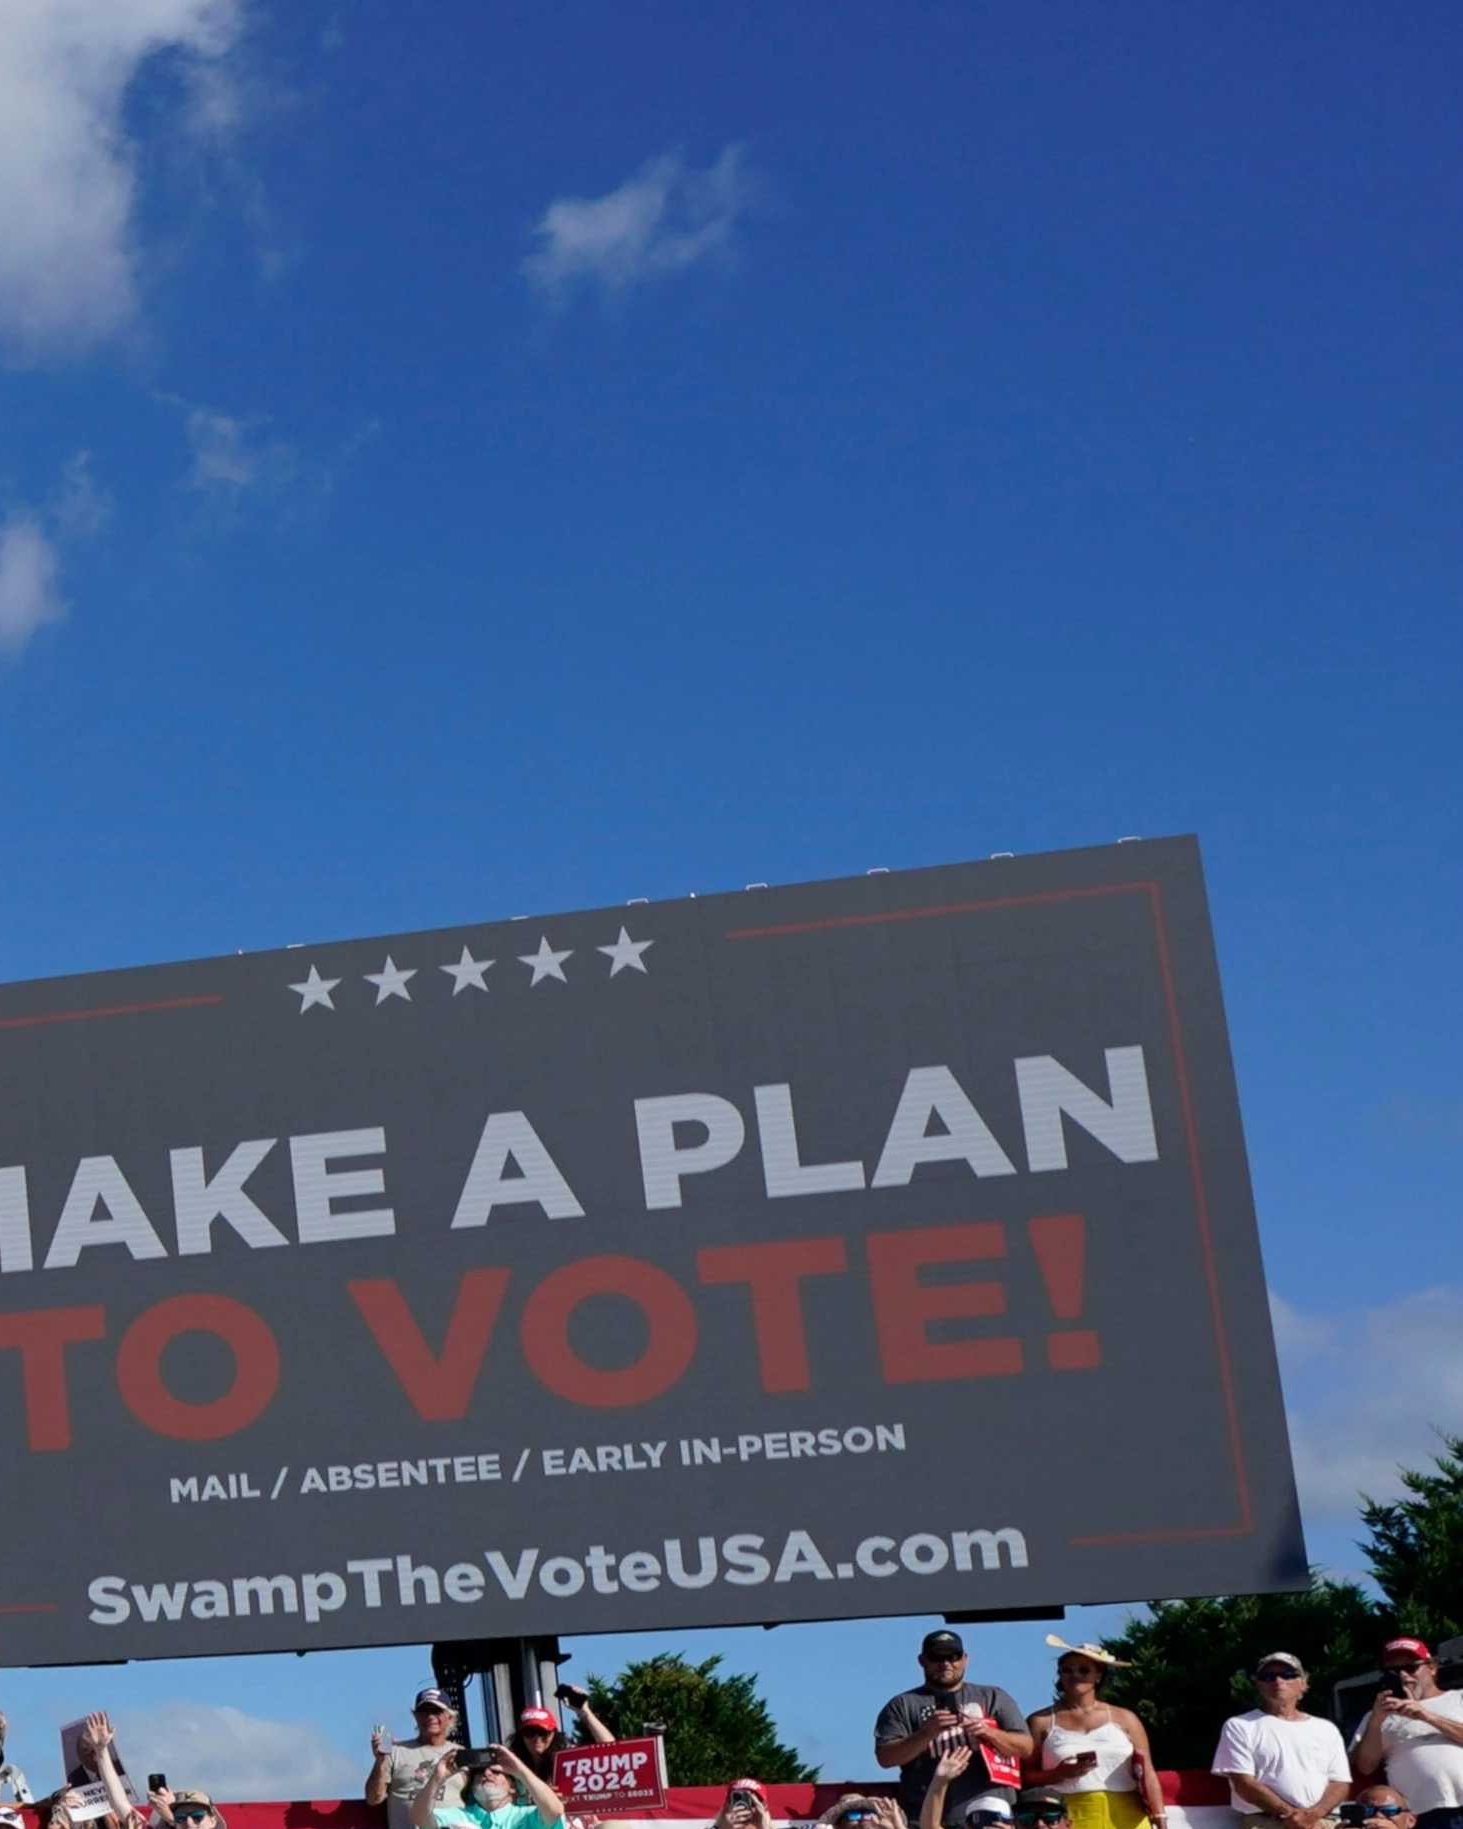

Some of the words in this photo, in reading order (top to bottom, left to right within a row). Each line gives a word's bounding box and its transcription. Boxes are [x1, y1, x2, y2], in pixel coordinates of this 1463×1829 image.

[449, 1109, 585, 1230] A
[633, 1044, 1159, 1211] PLAN
[346, 1213, 1102, 1423] VOTE!
[170, 1472, 261, 1503] MAIL
[300, 1453, 502, 1495] ABSENTEE
[542, 1440, 668, 1477] EARLY
[680, 1423, 907, 1467] IN-PERSON
[87, 1526, 1029, 1625] SwampTheVoteUSA.com
[562, 1751, 648, 1777] TRUMP
[572, 1770, 638, 1793] 2024
[614, 1791, 626, 1799] TO
